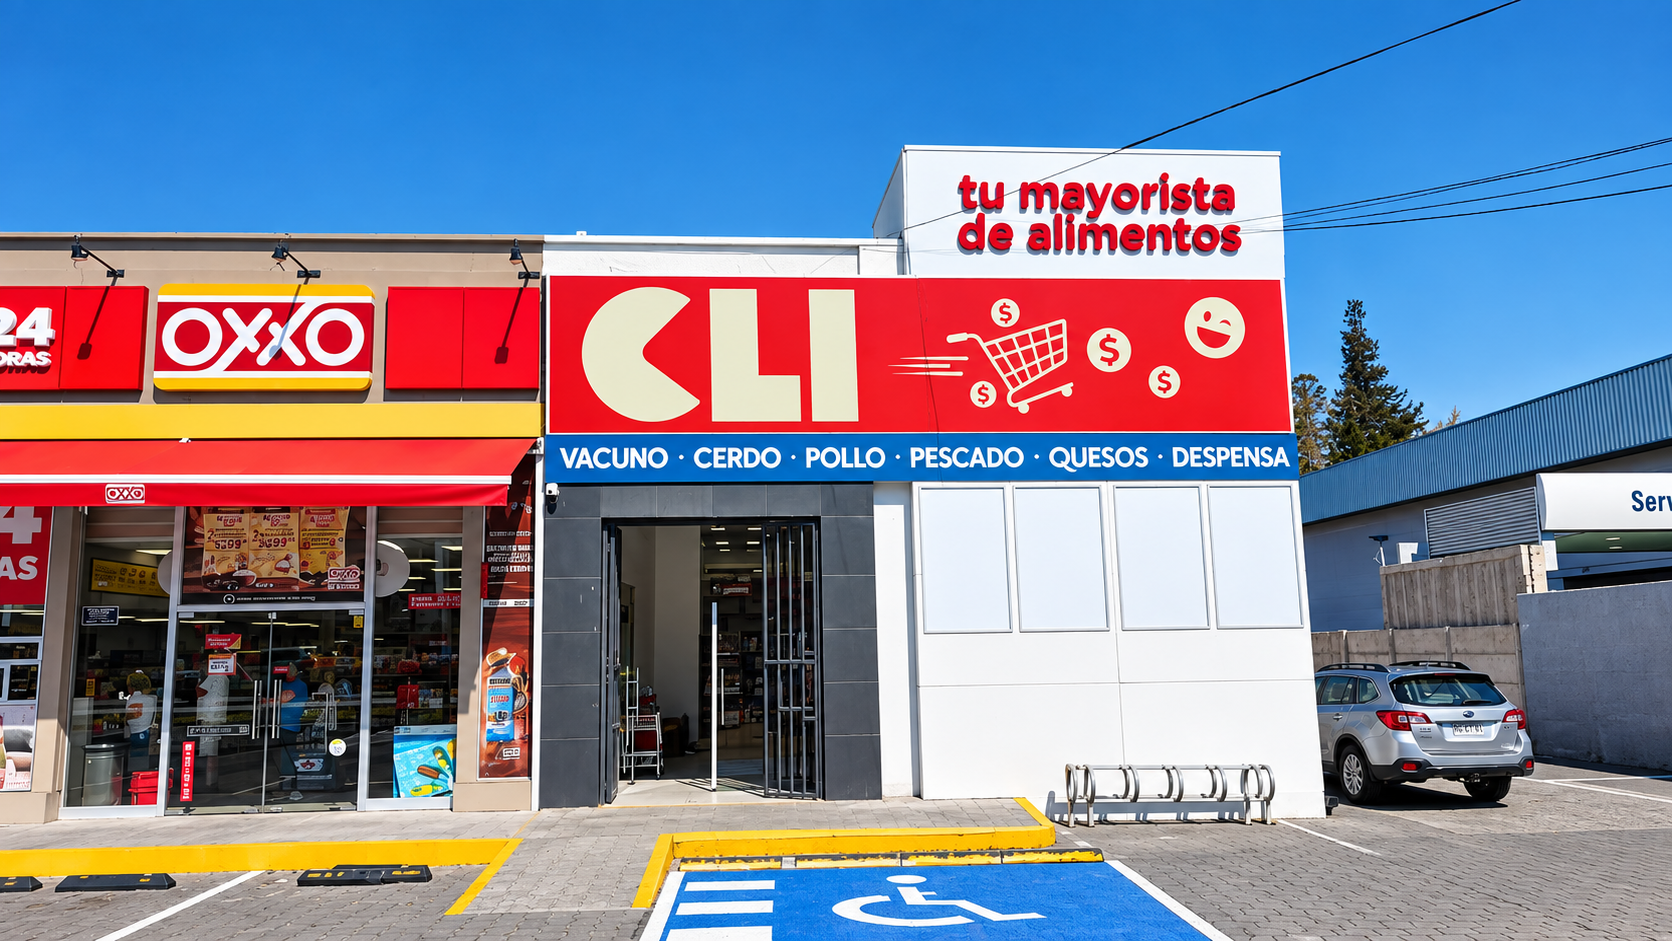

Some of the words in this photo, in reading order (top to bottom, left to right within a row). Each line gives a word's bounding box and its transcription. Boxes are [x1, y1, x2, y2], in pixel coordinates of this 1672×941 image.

[959, 175, 1004, 209] tu
[1020, 173, 1236, 219] mayorista
[958, 213, 1014, 250] de
[1027, 212, 1242, 251] alimentos
[162, 303, 365, 370] OXXO
[582, 286, 859, 422] CLI
[559, 447, 669, 469] VACUNO
[693, 447, 782, 469] CERDO
[805, 447, 886, 469] POLLO
[910, 447, 1025, 469] PESCADO
[1048, 447, 1149, 472] QUESOS
[1172, 447, 1291, 468] DESPENSA
[107, 486, 144, 500] OXXO
[0, 555, 38, 580] AS
